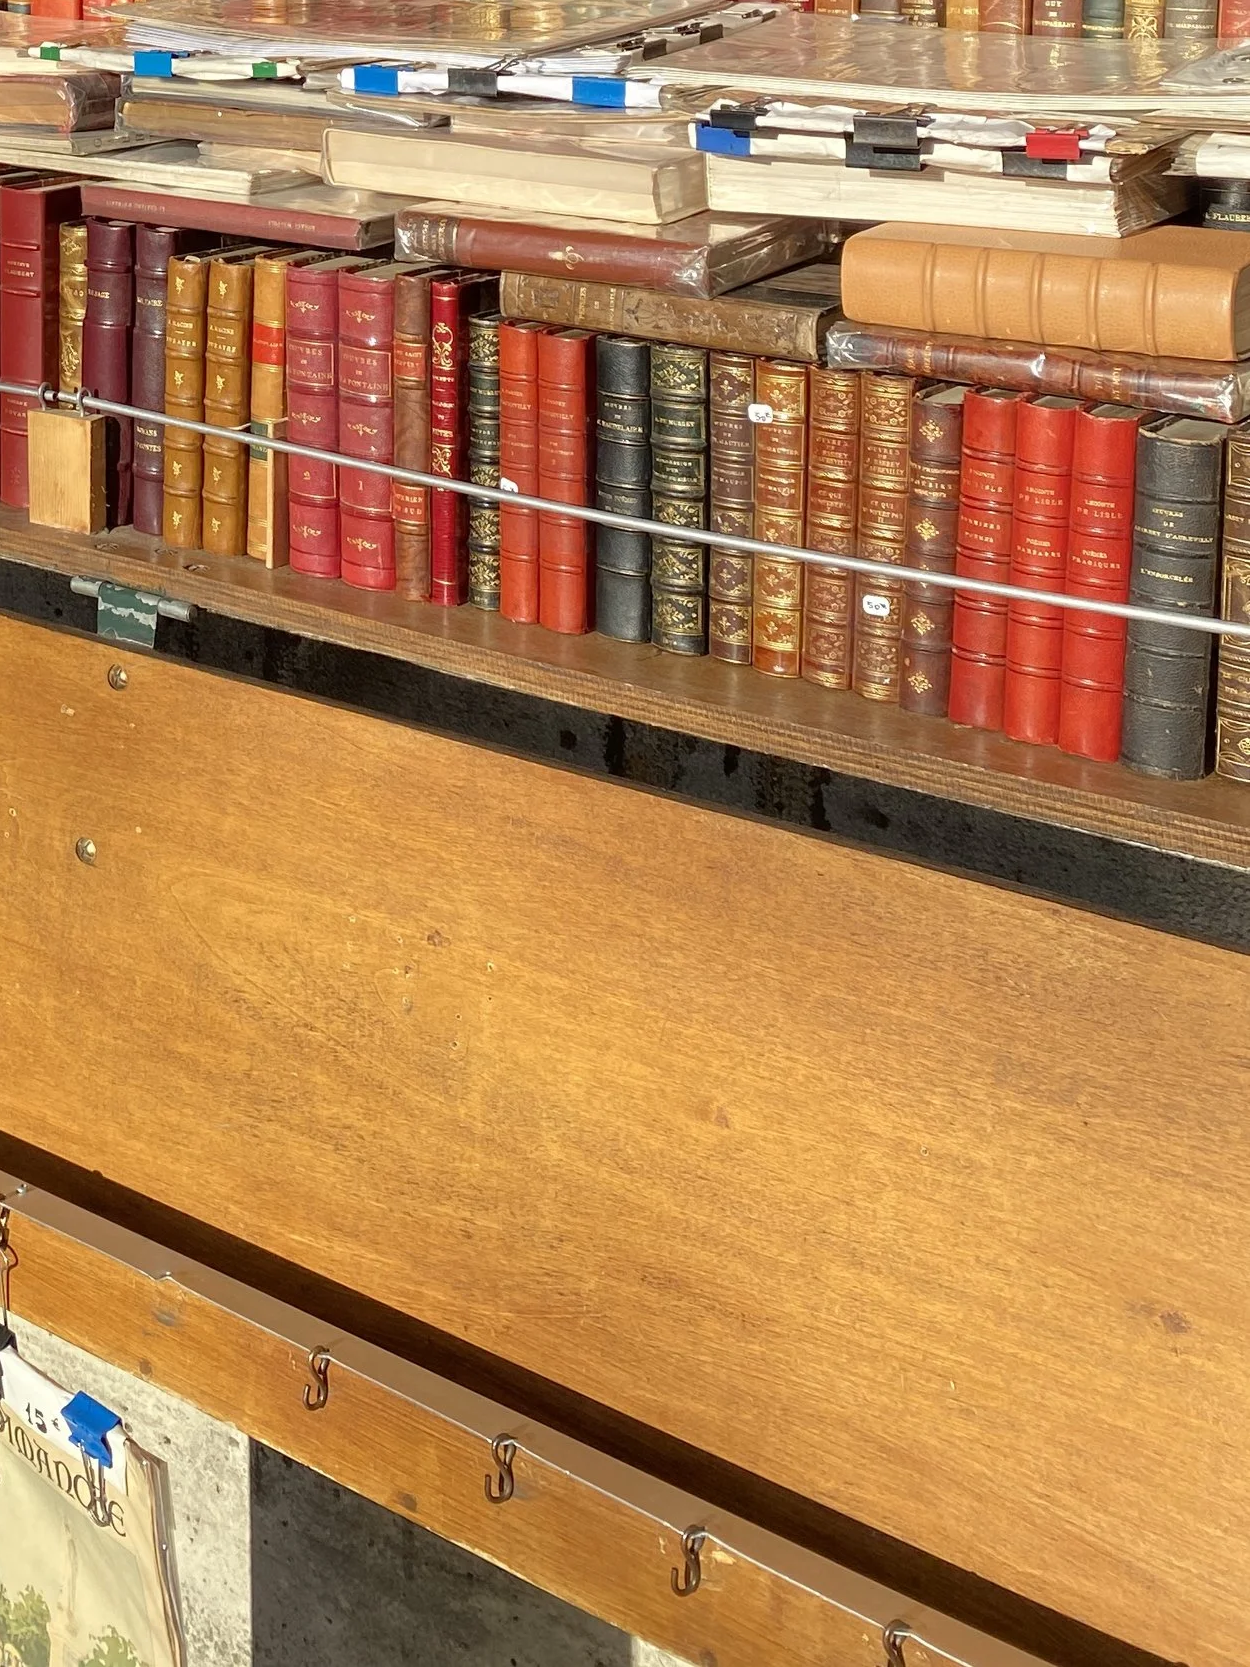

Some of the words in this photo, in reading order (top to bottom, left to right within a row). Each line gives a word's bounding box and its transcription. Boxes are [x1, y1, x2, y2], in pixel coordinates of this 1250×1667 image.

[880, 502, 894, 510] QUI
[1034, 496, 1063, 506] LISLE
[1093, 510, 1124, 520] LISLE
